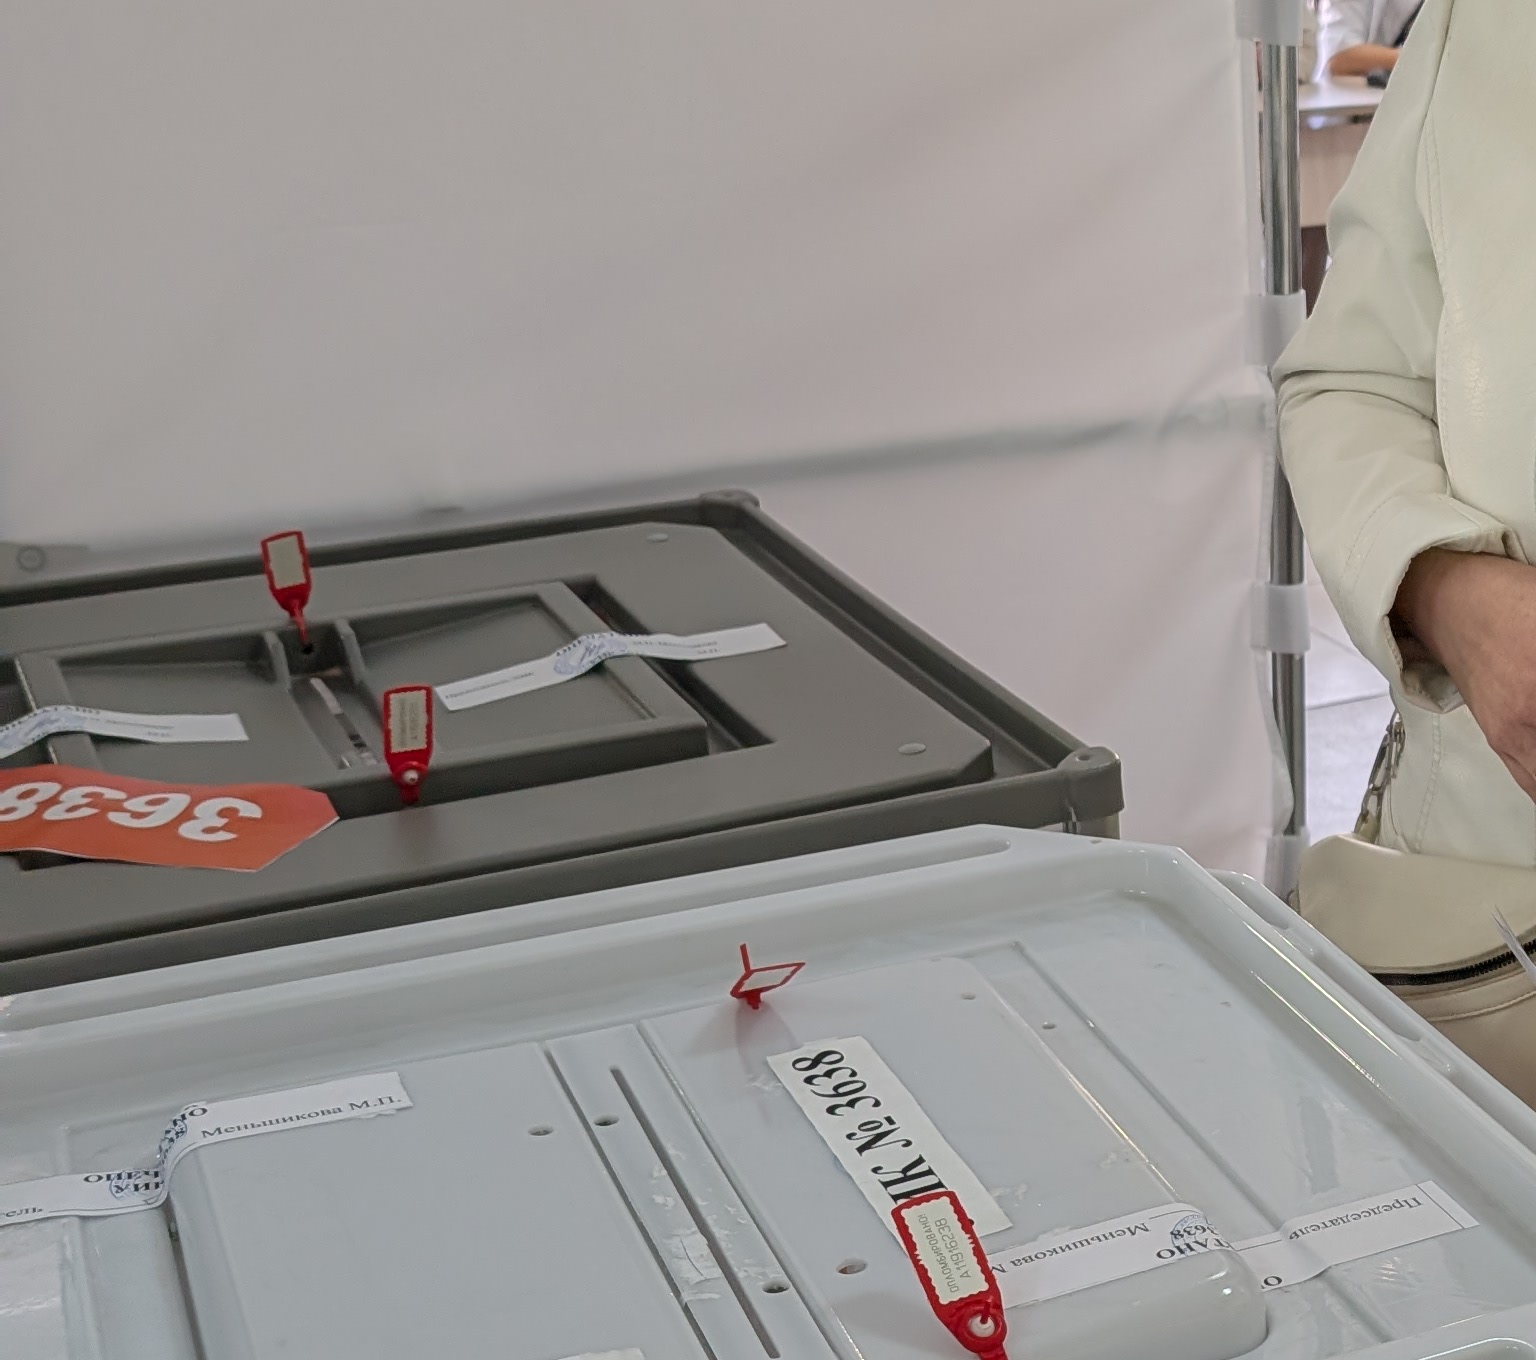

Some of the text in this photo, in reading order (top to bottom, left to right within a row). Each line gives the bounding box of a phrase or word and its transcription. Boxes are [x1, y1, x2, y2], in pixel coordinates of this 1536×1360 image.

[0, 781, 262, 842] 3638
[791, 1049, 882, 1117] 3638
[201, 1105, 342, 1139] Меньшикова
[1010, 1196, 1423, 1267] Председатель Меньшикова
